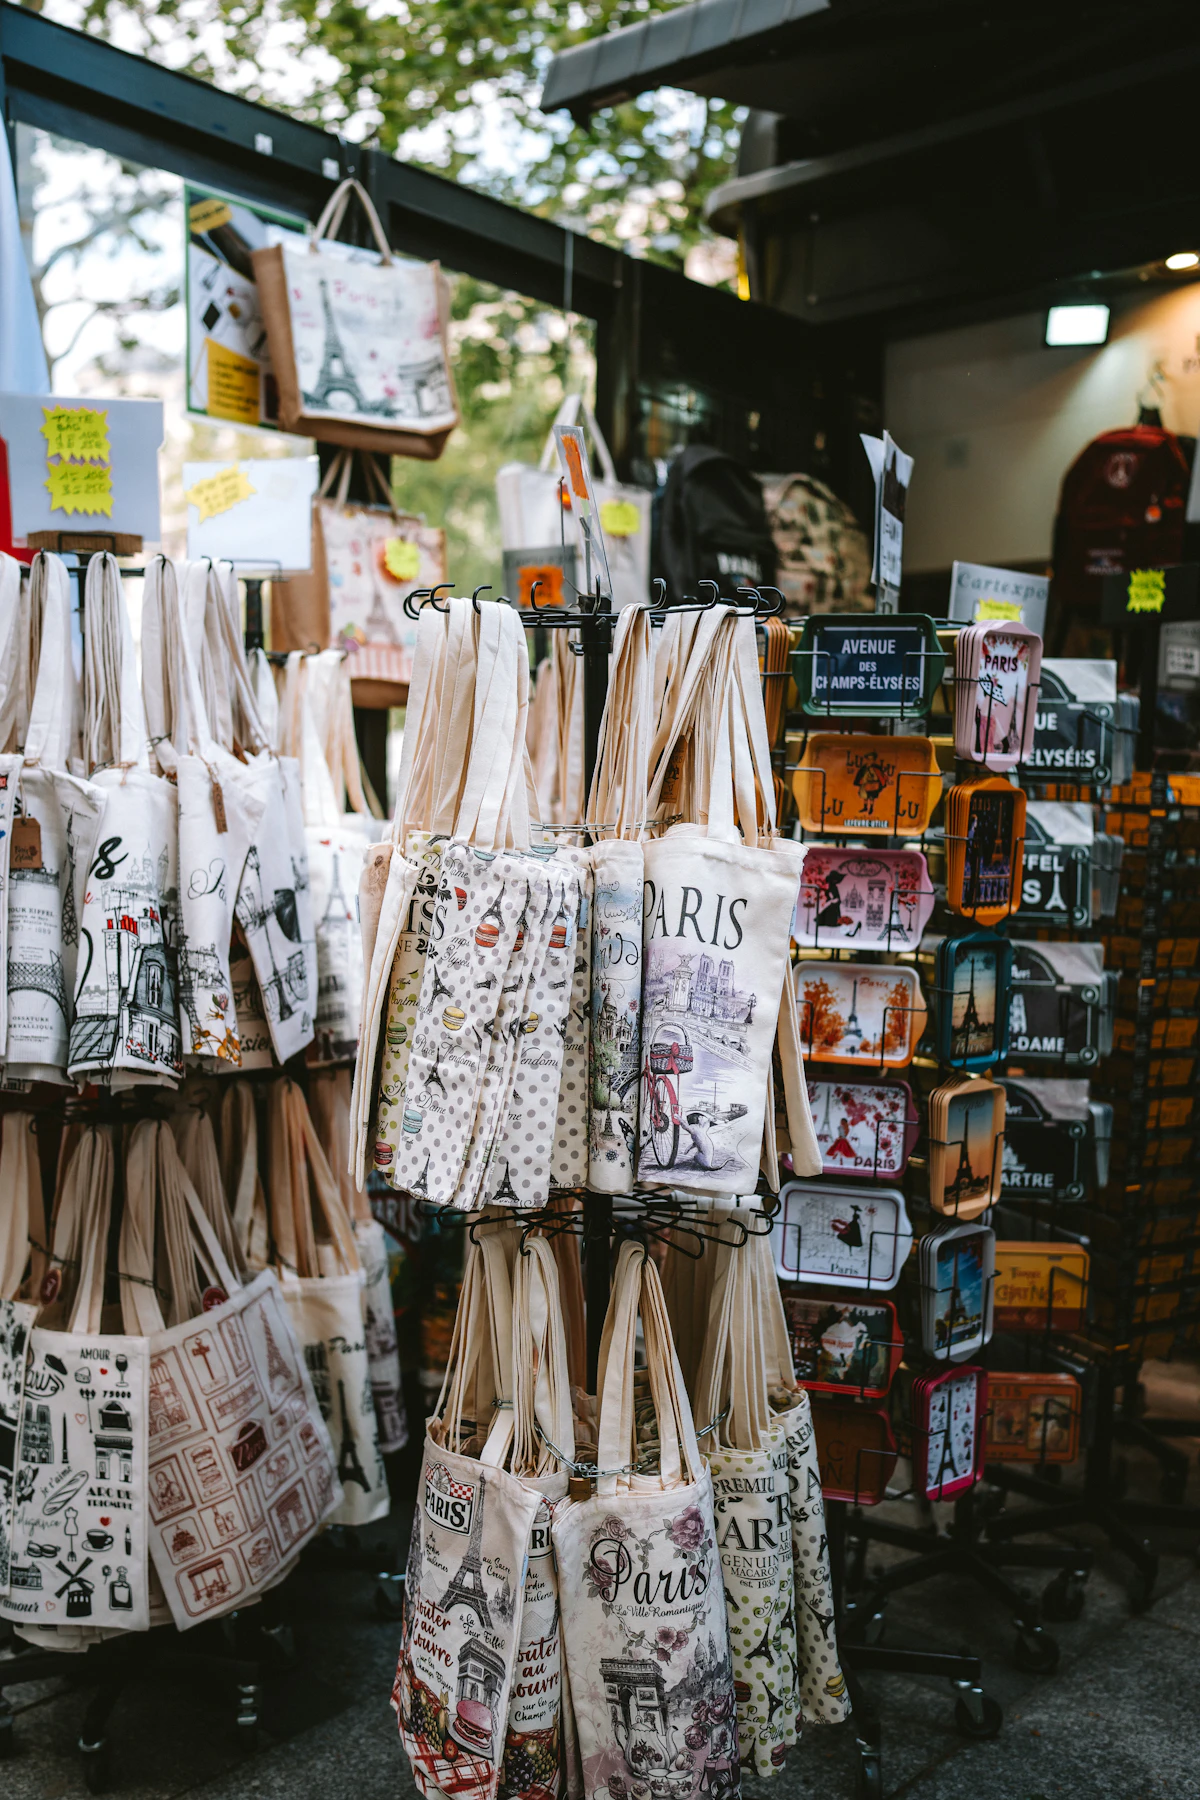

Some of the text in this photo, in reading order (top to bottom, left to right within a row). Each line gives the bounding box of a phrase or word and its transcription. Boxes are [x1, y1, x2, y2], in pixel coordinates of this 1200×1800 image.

[956, 572, 1047, 601] Cartexpo
[841, 639, 896, 655] AVENUE
[859, 661, 877, 672] DES
[984, 655, 1019, 674] PARIS
[896, 795, 920, 819] LU
[860, 976, 889, 988] Paris
[417, 1090, 447, 1115] Dame
[854, 1156, 896, 1170] PARIS
[830, 1263, 860, 1276] Paris
[80, 1349, 110, 1361] AMOUR
[49, 1466, 73, 1489] t'aime
[87, 1487, 114, 1498] ARC
[87, 1500, 133, 1510] TRIOMPHE
[425, 1486, 467, 1527] PARIS
[482, 1556, 493, 1566] au
[526, 1567, 539, 1580] Au
[590, 1538, 708, 1605] Paris
[739, 1578, 776, 1589] est. 1935
[628, 1605, 650, 1617] Ville
[650, 1599, 705, 1617] Romantique
[466, 1613, 475, 1626] la
[421, 1620, 437, 1638] au
[463, 1622, 506, 1650] Tour Eiffel
[522, 1662, 547, 1679] au
[522, 1696, 548, 1712] sur les
[515, 1708, 547, 1723] Champs
[743, 1705, 761, 1722] La
